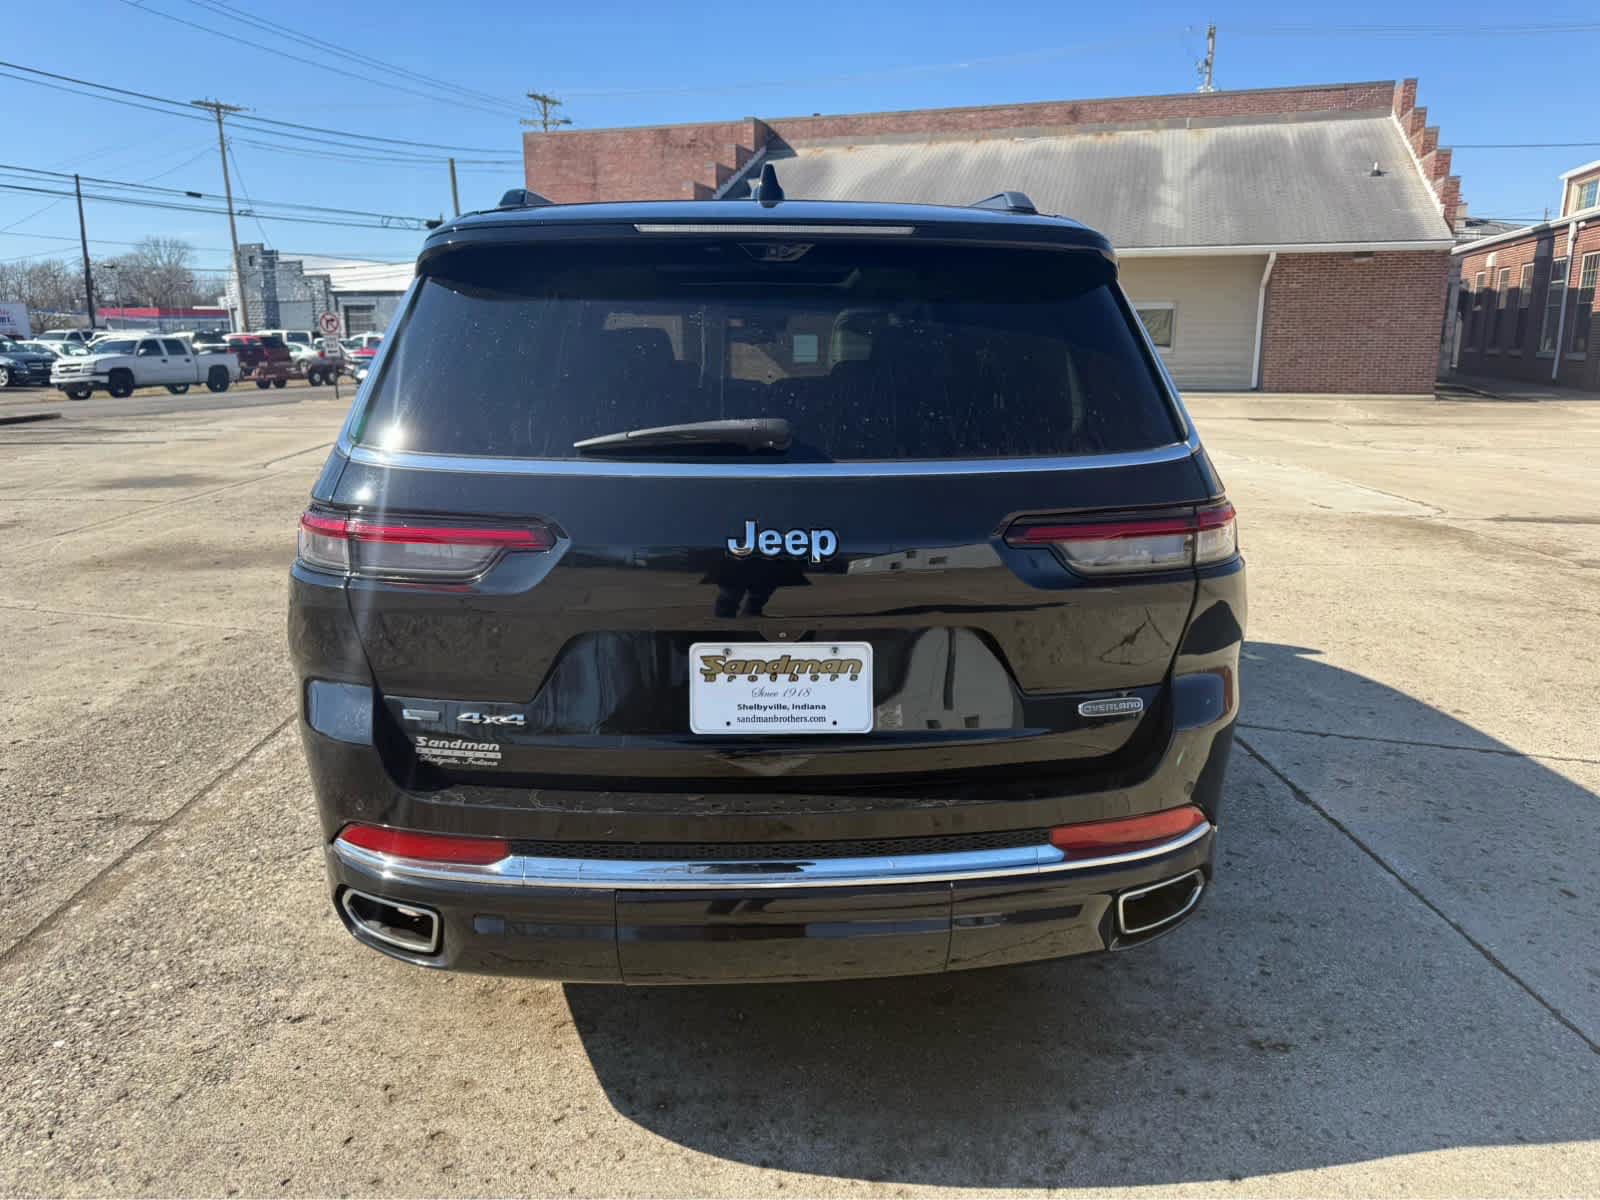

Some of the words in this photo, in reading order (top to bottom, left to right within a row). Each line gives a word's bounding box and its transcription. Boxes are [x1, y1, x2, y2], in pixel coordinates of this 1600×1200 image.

[727, 519, 838, 563] Jeep
[699, 655, 863, 674] Sandman
[782, 687, 812, 698] 1918
[737, 703, 790, 712] Shelbyville,
[791, 703, 827, 711] Indiana
[456, 712, 527, 726] 4x4
[736, 714, 827, 723] sandmanbrothers.com
[415, 736, 500, 751] Sandman
